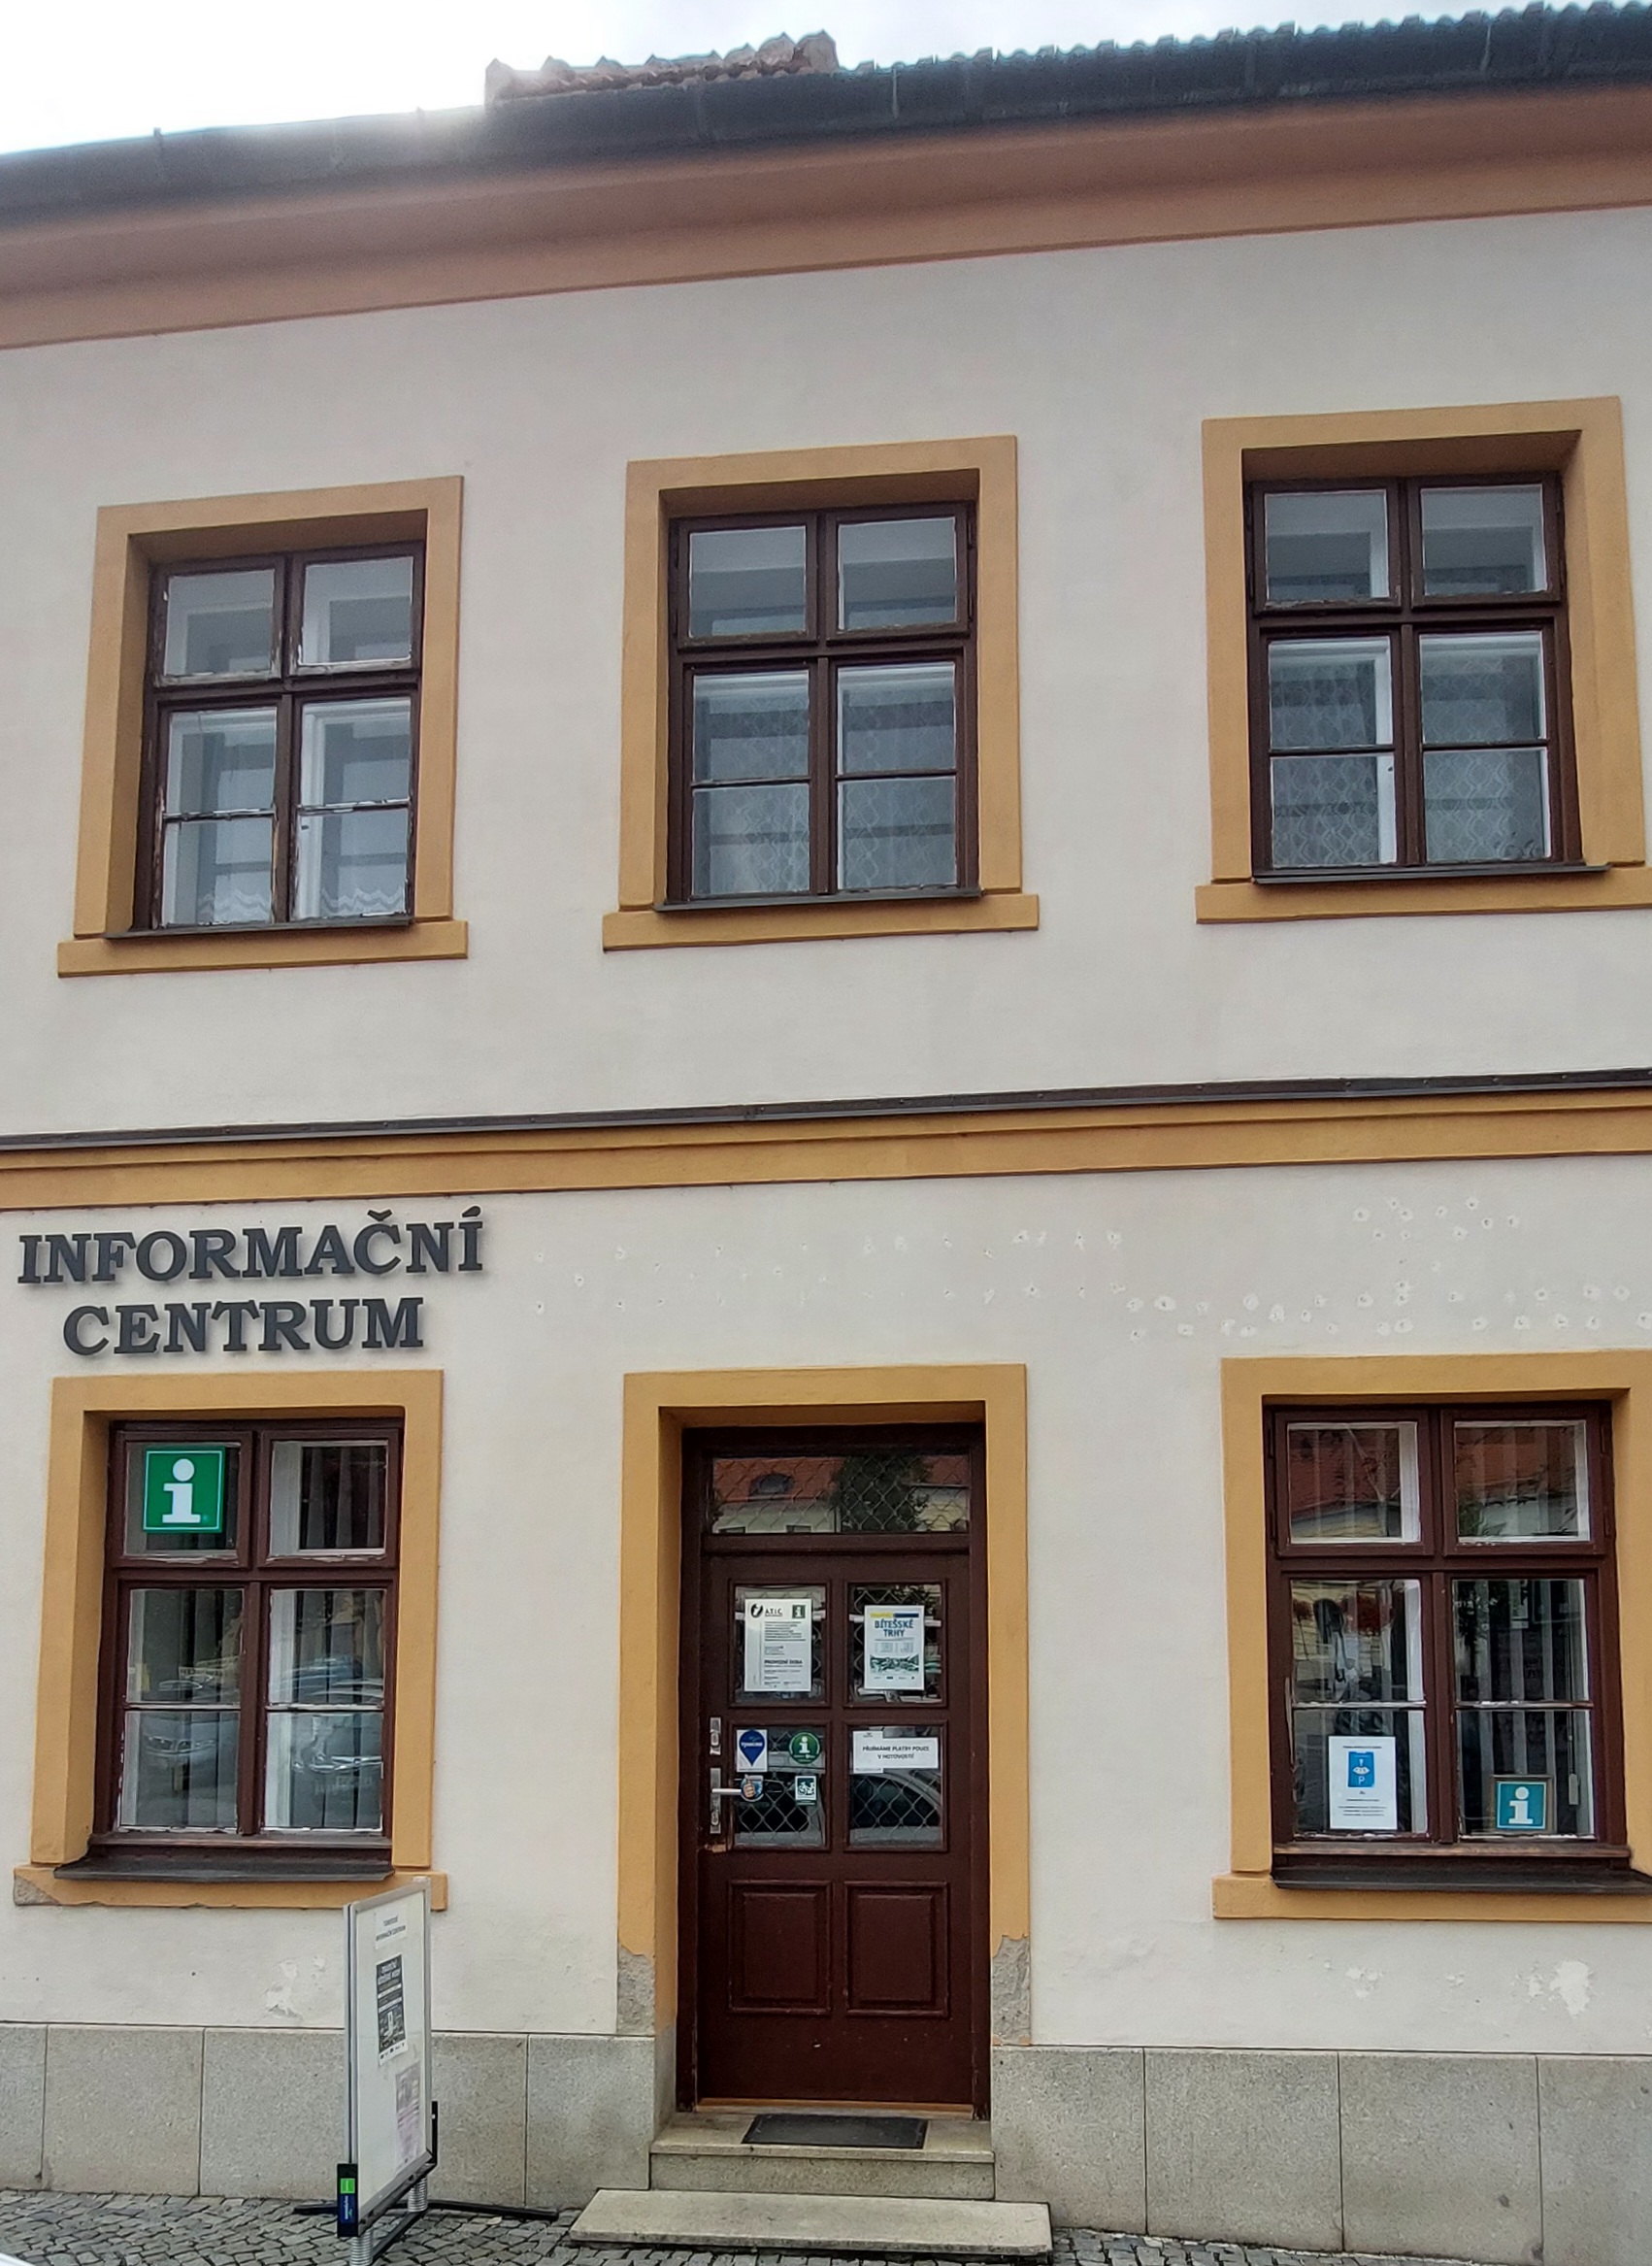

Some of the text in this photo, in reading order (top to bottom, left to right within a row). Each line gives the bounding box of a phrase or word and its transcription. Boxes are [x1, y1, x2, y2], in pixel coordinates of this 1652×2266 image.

[17, 1205, 484, 1284] INFORMAČNÍ
[62, 1297, 424, 1356] CENTRUM
[875, 1618, 914, 1629] BÍTEŠSKÉ
[883, 1629, 906, 1638] TRHY
